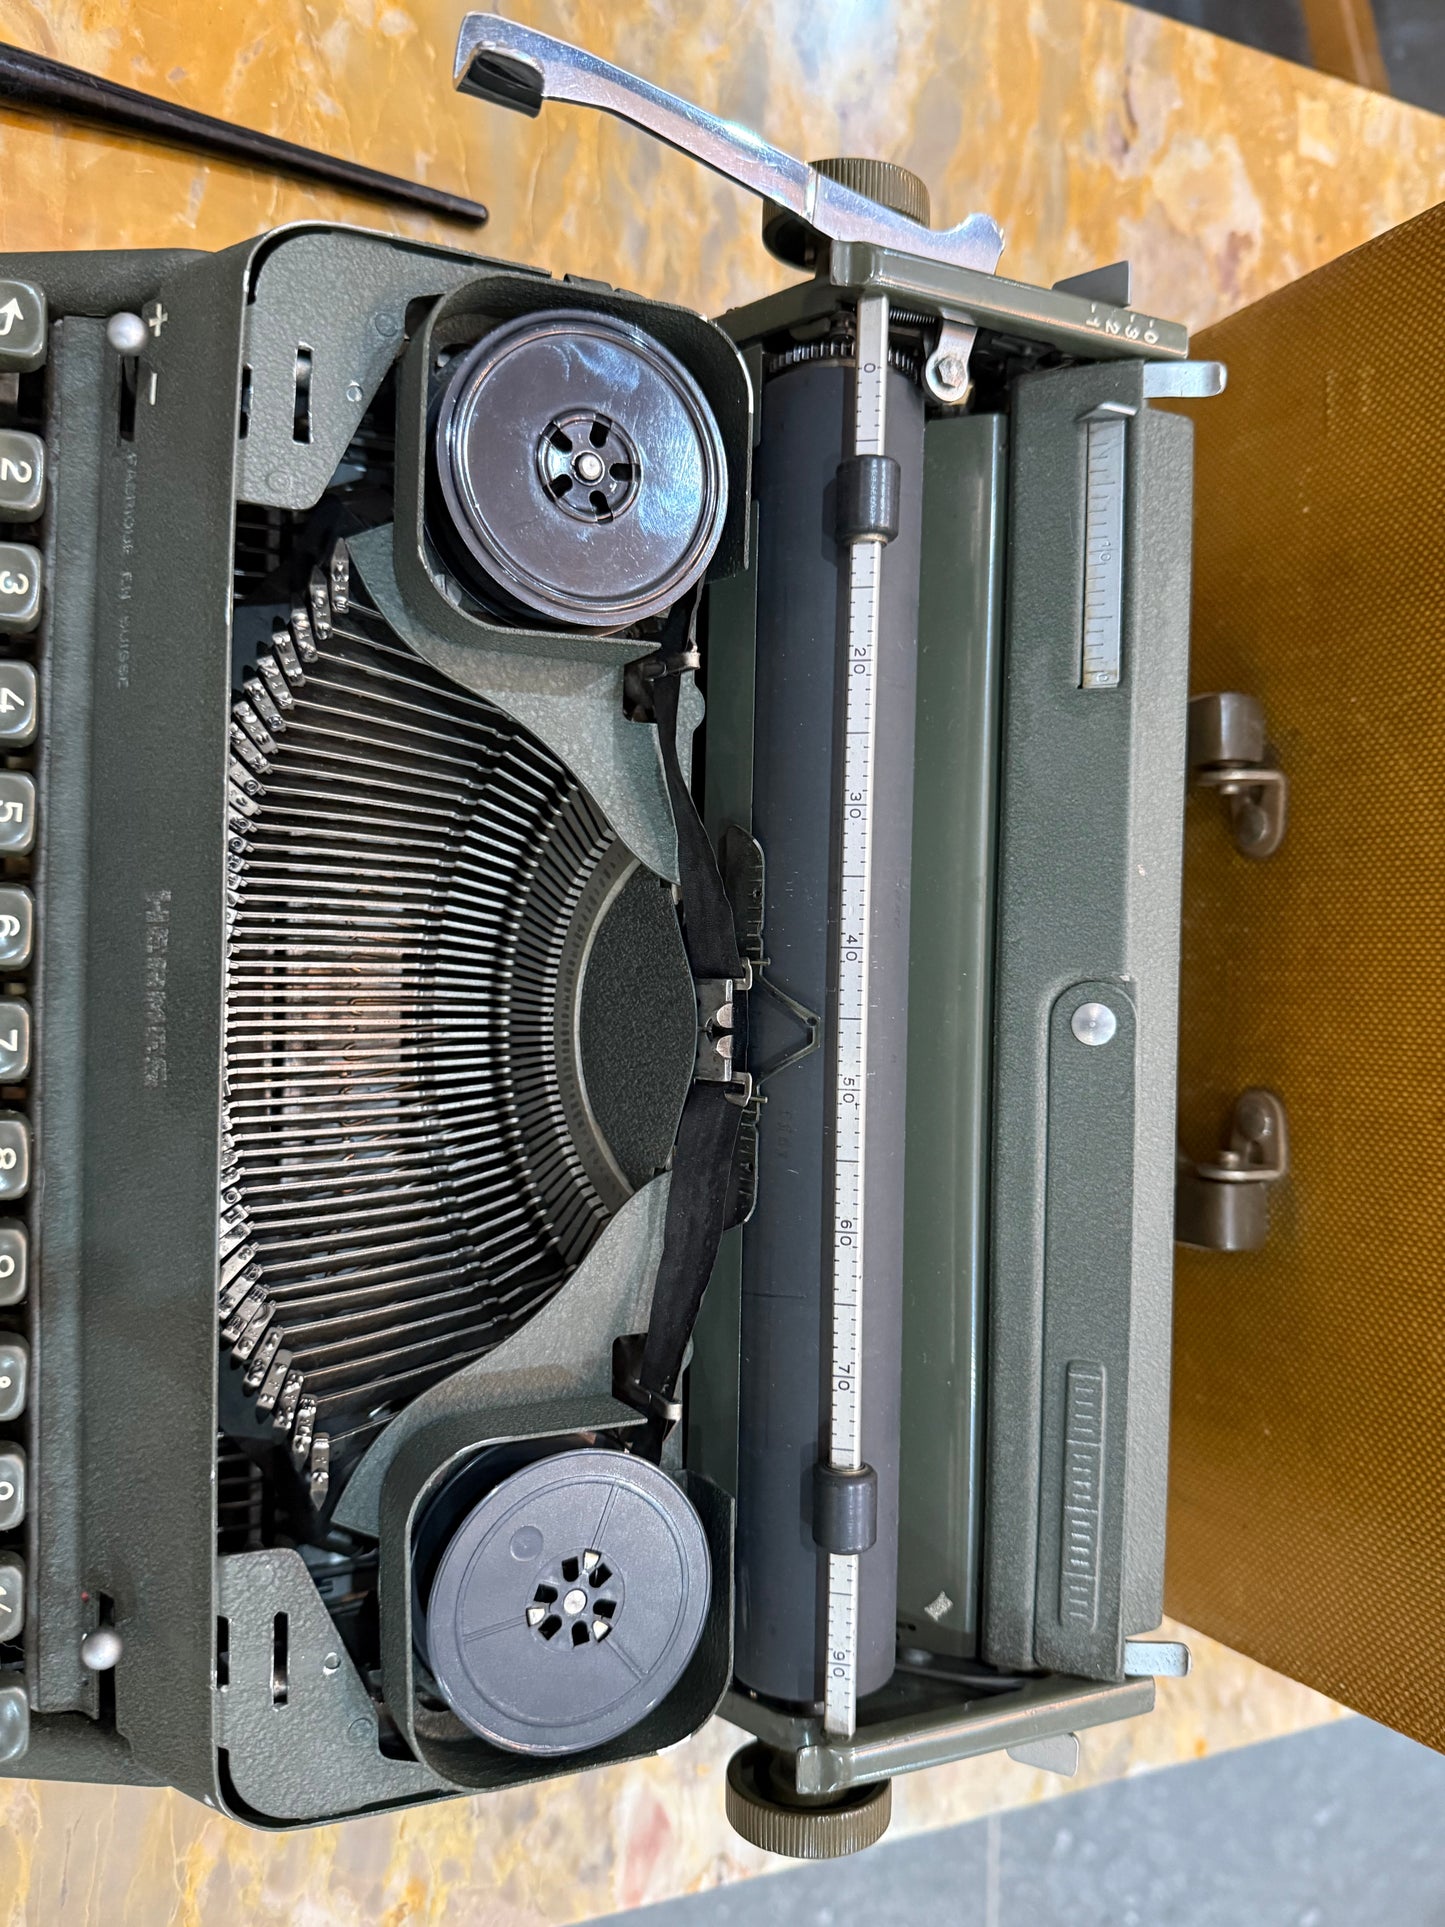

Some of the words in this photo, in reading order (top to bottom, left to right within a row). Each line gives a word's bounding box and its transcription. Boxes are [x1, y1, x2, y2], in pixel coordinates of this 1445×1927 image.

[1106, 318, 1121, 335] 2
[1125, 325, 1141, 340] 3
[863, 362, 876, 374] 0
[0, 457, 33, 484] 2
[0, 570, 30, 595] 3
[117, 615, 131, 689] SUISSE
[853, 647, 867, 675] 20
[0, 687, 25, 714] 4
[0, 801, 24, 823] 5
[849, 792, 862, 819] 30
[845, 934, 858, 962] 40
[144, 889, 172, 1089] HERMES
[842, 1076, 855, 1104] 50
[839, 1219, 853, 1246] 60
[837, 1364, 851, 1391] 70
[832, 1651, 846, 1678] 90
